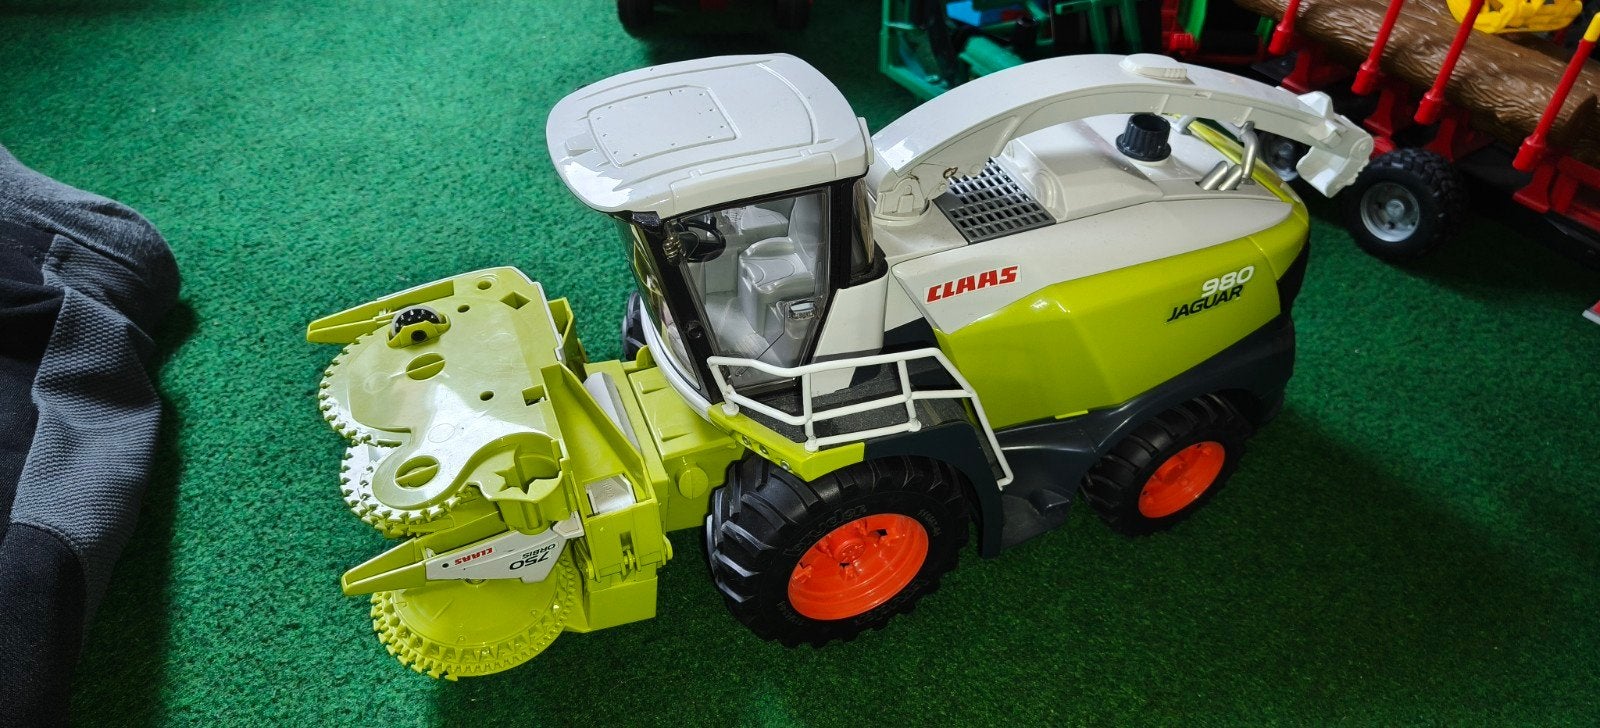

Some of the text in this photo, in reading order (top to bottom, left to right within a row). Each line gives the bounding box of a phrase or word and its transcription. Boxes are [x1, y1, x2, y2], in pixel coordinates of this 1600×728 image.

[926, 265, 1019, 303] CLAAS
[1201, 265, 1255, 298] 980
[1166, 285, 1244, 322] JAGUAR
[454, 547, 493, 565] CLAAS
[509, 551, 549, 570] 750
[522, 543, 555, 558] ORBIS
